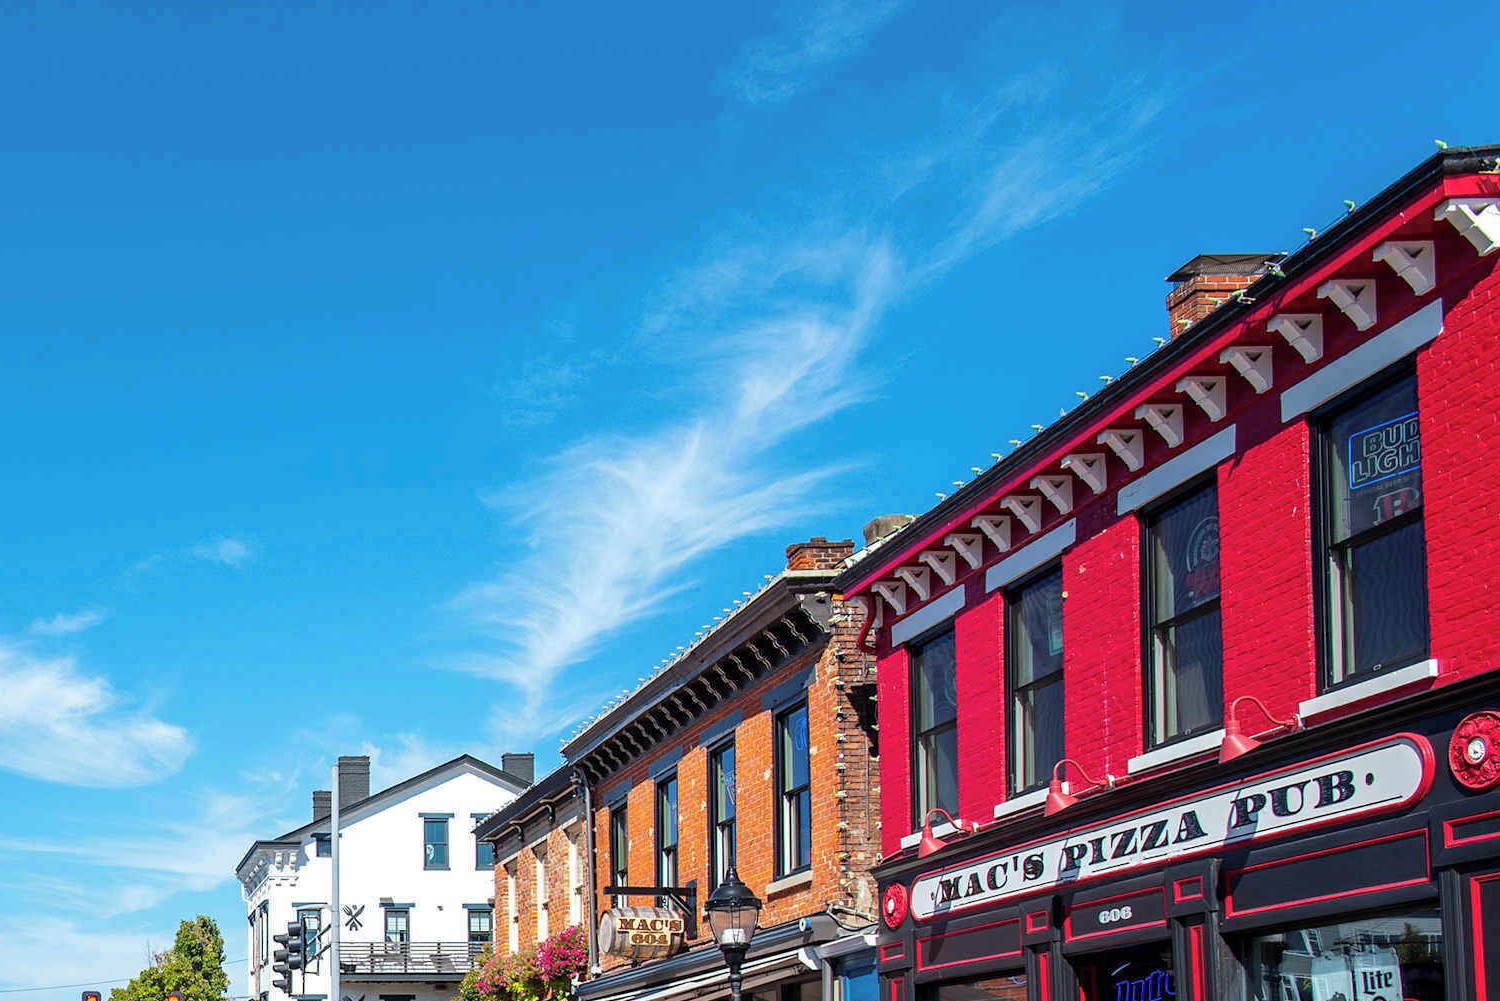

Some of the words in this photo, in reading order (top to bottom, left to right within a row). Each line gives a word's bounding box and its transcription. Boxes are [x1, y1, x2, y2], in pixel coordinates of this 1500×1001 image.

[1364, 417, 1419, 457] BUD
[1351, 439, 1421, 484] LIGH
[937, 852, 1045, 904] MAC'S
[1062, 810, 1208, 872] PIZZA
[618, 918, 682, 931] MAC'S
[1099, 905, 1133, 924] 606
[1361, 971, 1393, 995] Lite
